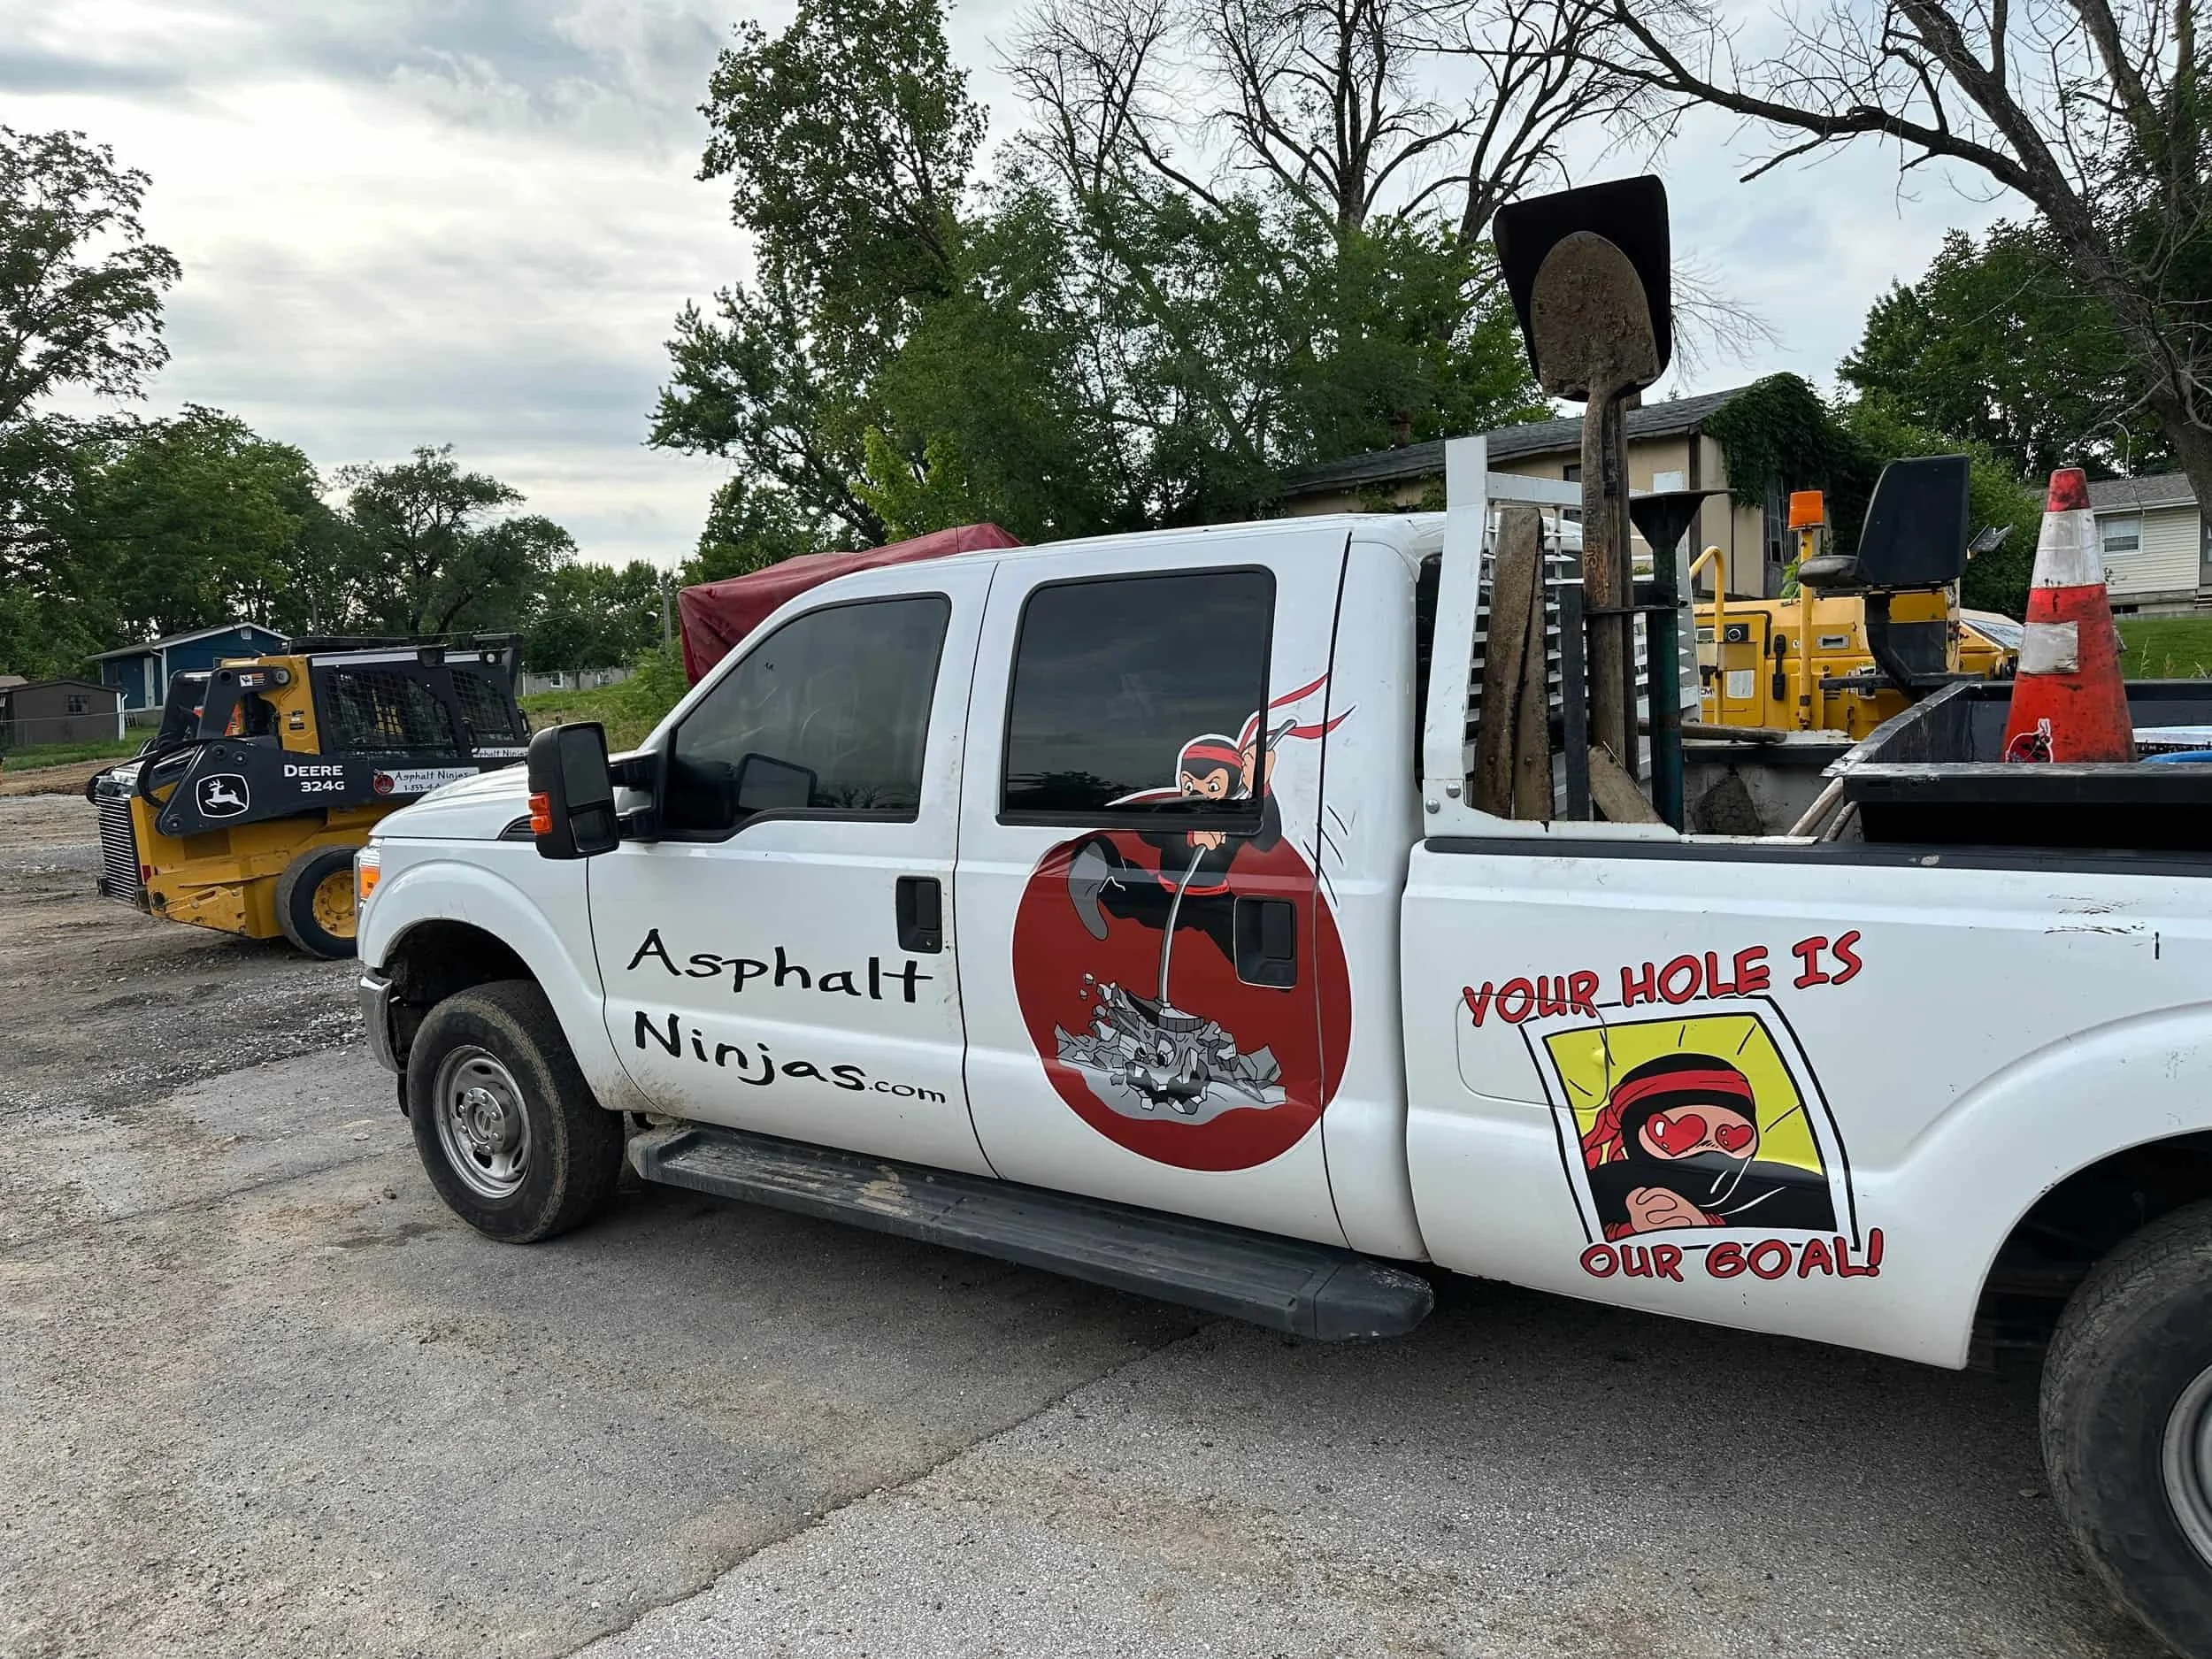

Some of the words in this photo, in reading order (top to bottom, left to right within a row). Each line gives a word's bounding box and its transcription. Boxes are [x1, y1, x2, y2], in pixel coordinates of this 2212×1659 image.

[283, 764, 343, 777] DEERE
[472, 749, 500, 758] phalt
[301, 780, 345, 792] 324G
[394, 771, 434, 782] Asphalt
[626, 928, 934, 1003] Asphalt
[1463, 970, 1600, 1027] YOUR
[1620, 945, 1770, 1007] HOLE
[1792, 930, 1863, 990] IS
[634, 1010, 946, 1103] Ninjas.com
[1580, 1244, 1685, 1282] OUR
[1704, 1227, 1885, 1279] GOAL!
